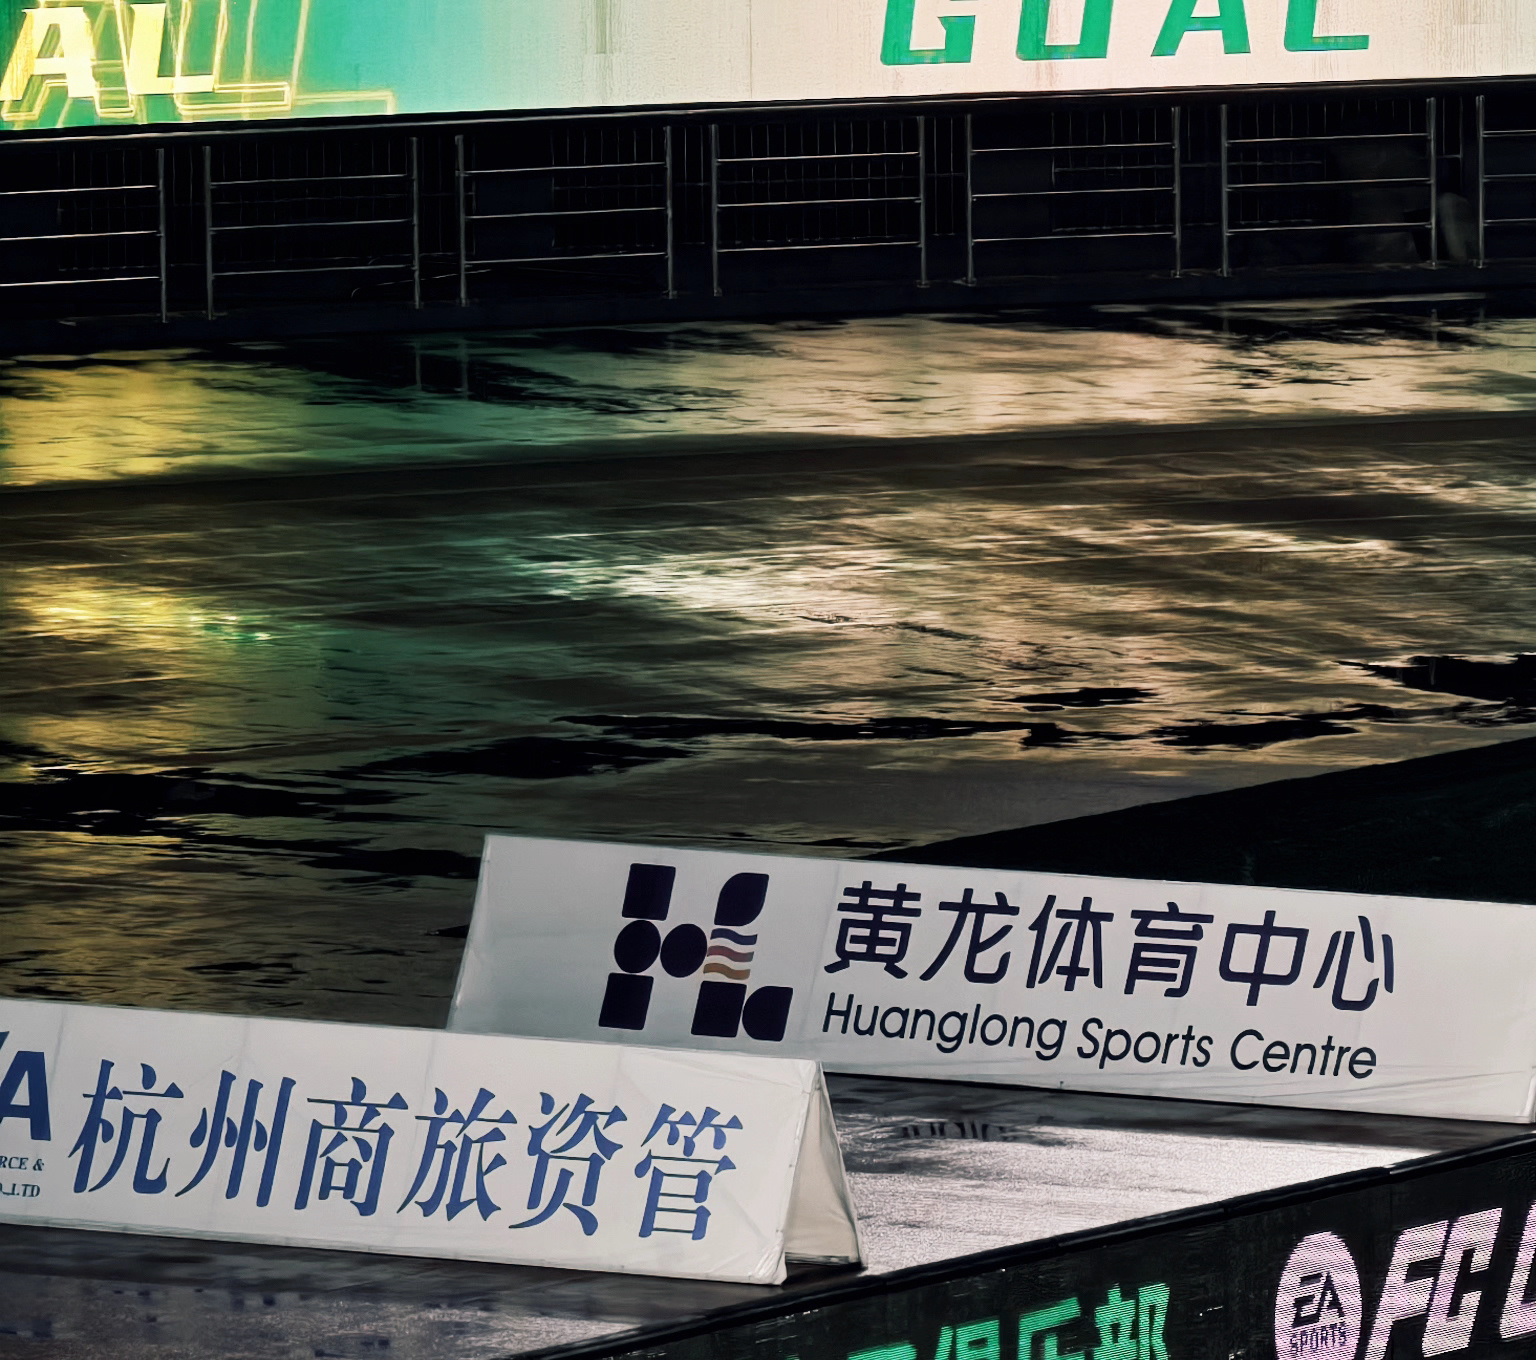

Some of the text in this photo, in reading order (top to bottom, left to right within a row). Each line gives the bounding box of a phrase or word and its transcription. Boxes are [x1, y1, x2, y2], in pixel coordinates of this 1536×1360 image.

[824, 881, 1394, 1011] 黄龙体育中心
[822, 992, 1378, 1079] Huanglong Sports Centre
[68, 1059, 745, 1241] 杭州商旅资管
[1289, 1322, 1348, 1357] SPORTS
[1292, 1271, 1346, 1328] EA
